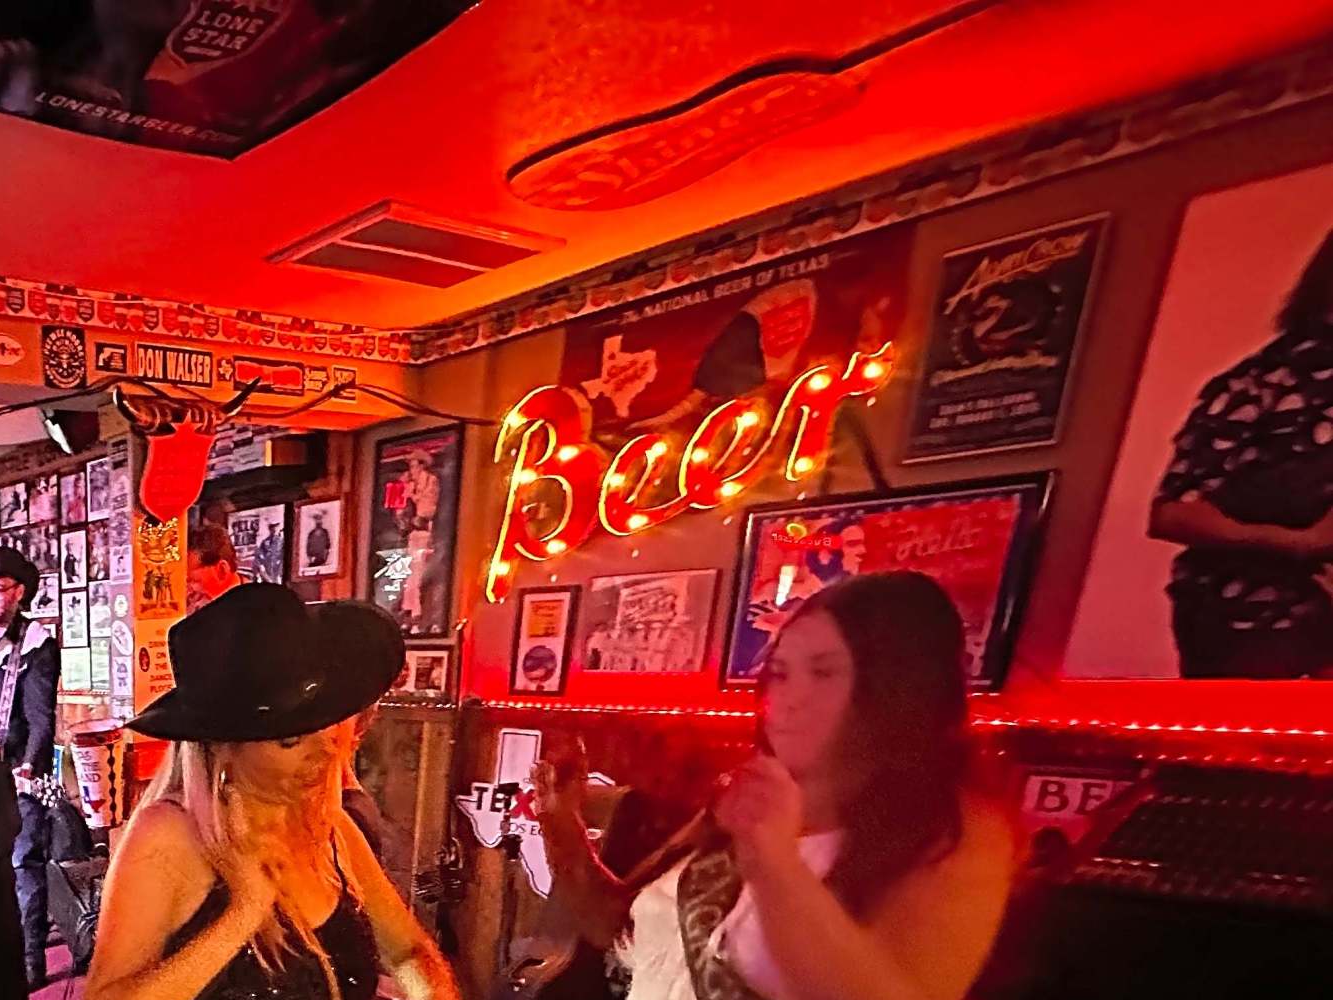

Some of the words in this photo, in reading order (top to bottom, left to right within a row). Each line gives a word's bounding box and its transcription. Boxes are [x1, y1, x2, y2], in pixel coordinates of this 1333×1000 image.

[182, 26, 249, 51] STAR
[195, 9, 265, 36] LONE
[644, 291, 710, 319] NATIONAL
[713, 275, 753, 299] BEER
[755, 270, 773, 287] OF
[778, 254, 830, 279] TEXAS
[138, 348, 164, 379] DON
[166, 351, 211, 384] WALSER
[487, 341, 894, 603] Beer
